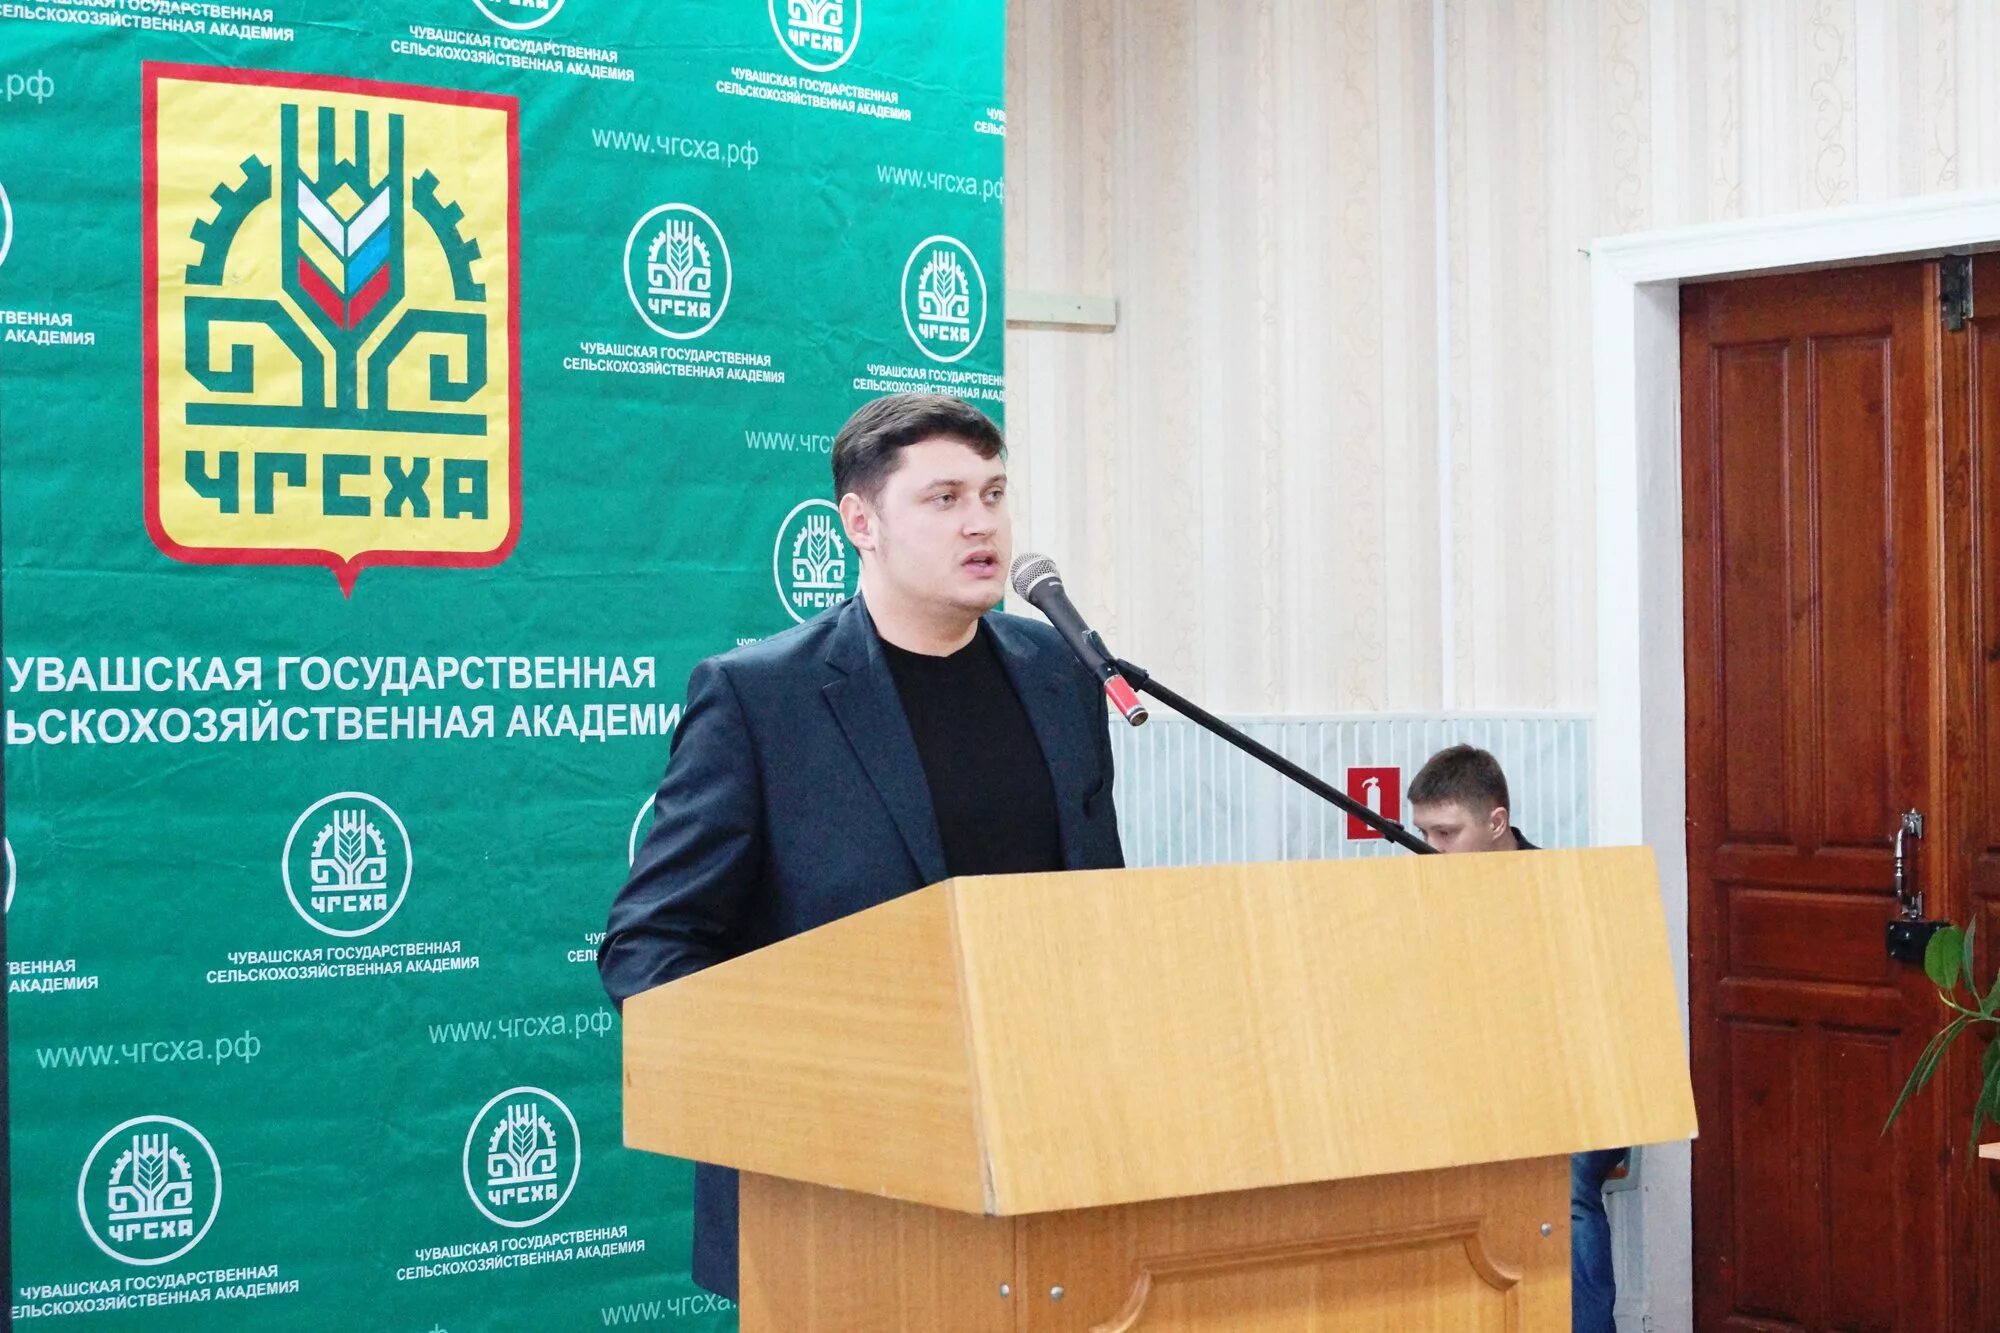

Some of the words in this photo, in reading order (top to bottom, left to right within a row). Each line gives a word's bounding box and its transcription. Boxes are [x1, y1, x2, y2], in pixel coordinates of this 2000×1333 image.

[0, 4, 205, 34] ЕЛЬСКОХОЗЯЙСТВЕННАЯ
[209, 22, 294, 41] АКАДЕМИЯ
[119, 0, 274, 22] ГОСУДАРСТВЕННАЯ
[409, 25, 491, 47] ЧУВАШСКАЯ
[494, 36, 618, 63] ГОСУДАРСТВЕННАЯ
[788, 29, 844, 53] ЧГСХА
[391, 40, 563, 73] СЕЛЬСКОХОЗЯЙСТВЕННАЯ
[566, 62, 635, 82] АКАДЕМИЯ
[731, 66, 797, 88] ЧУВАШСКАЯ
[799, 77, 899, 104] ГОСУДАРСТВЕННАЯ
[715, 80, 856, 112] СЕЛЬСКОХОЗЯЙСТВЕННАЯ
[857, 102, 911, 121] АКАДЕМИЯ
[591, 127, 759, 171] www.чгсха.рф
[648, 297, 711, 319] ЧГСХА
[5, 328, 95, 346] АКАДЕМИЯ
[918, 323, 970, 343] ЧГСХА
[580, 342, 658, 359] ЧУВАШСКАЯ
[660, 346, 772, 367] ГОСУДАРСТВЕННАЯ
[563, 357, 725, 380] СЕЛЬСКОХОЗЯЙСТВЕННАЯ
[726, 366, 785, 384] АКАДЕМИЯ
[866, 363, 926, 380] ЧУВАШСКАЯ
[185, 450, 488, 520] ЧГСХА
[6, 656, 262, 692] УВАШСКАЯ
[278, 655, 656, 696] ГОСУДАРСТВЕННАЯ
[6, 699, 494, 745] ЬСКОХОЗЯЙСТВЕННАЯ
[506, 703, 688, 743] АКАДЕМИ
[311, 895, 387, 913] ЧГСХА
[227, 946, 323, 965] ЧУВАШСКАЯ
[326, 940, 461, 961] ГОСУДАРСТВЕННАЯ
[6, 959, 76, 975] ВЕННАЯ
[206, 960, 403, 984] СЕЛЬСКОХОЗЯЙСТВЕННАЯ
[405, 956, 480, 976] АКАДЕМИЯ
[8, 976, 99, 993] АКАДЕМИЯ
[427, 1006, 612, 1045] www.чгсха.рф
[36, 1030, 261, 1069] www.чгсха.рф
[488, 1185, 558, 1206] ЧГСХА
[108, 1219, 194, 1242] ЧГСХА
[415, 1239, 498, 1261] ЧУВАШСКАЯ
[501, 1226, 628, 1254] ГОСУДАРСТВЕННАЯ
[396, 1249, 573, 1281] СЕЛЬСКОХОЗЯЙСТВЕННАЯ
[576, 1239, 645, 1262] АКАДЕМИЯ
[20, 1278, 120, 1300] ЧУВАШСКАЯ
[125, 1264, 278, 1291] ГОСУДАРСТВЕННАЯ
[215, 1279, 299, 1300] АКАДЕМИЯ
